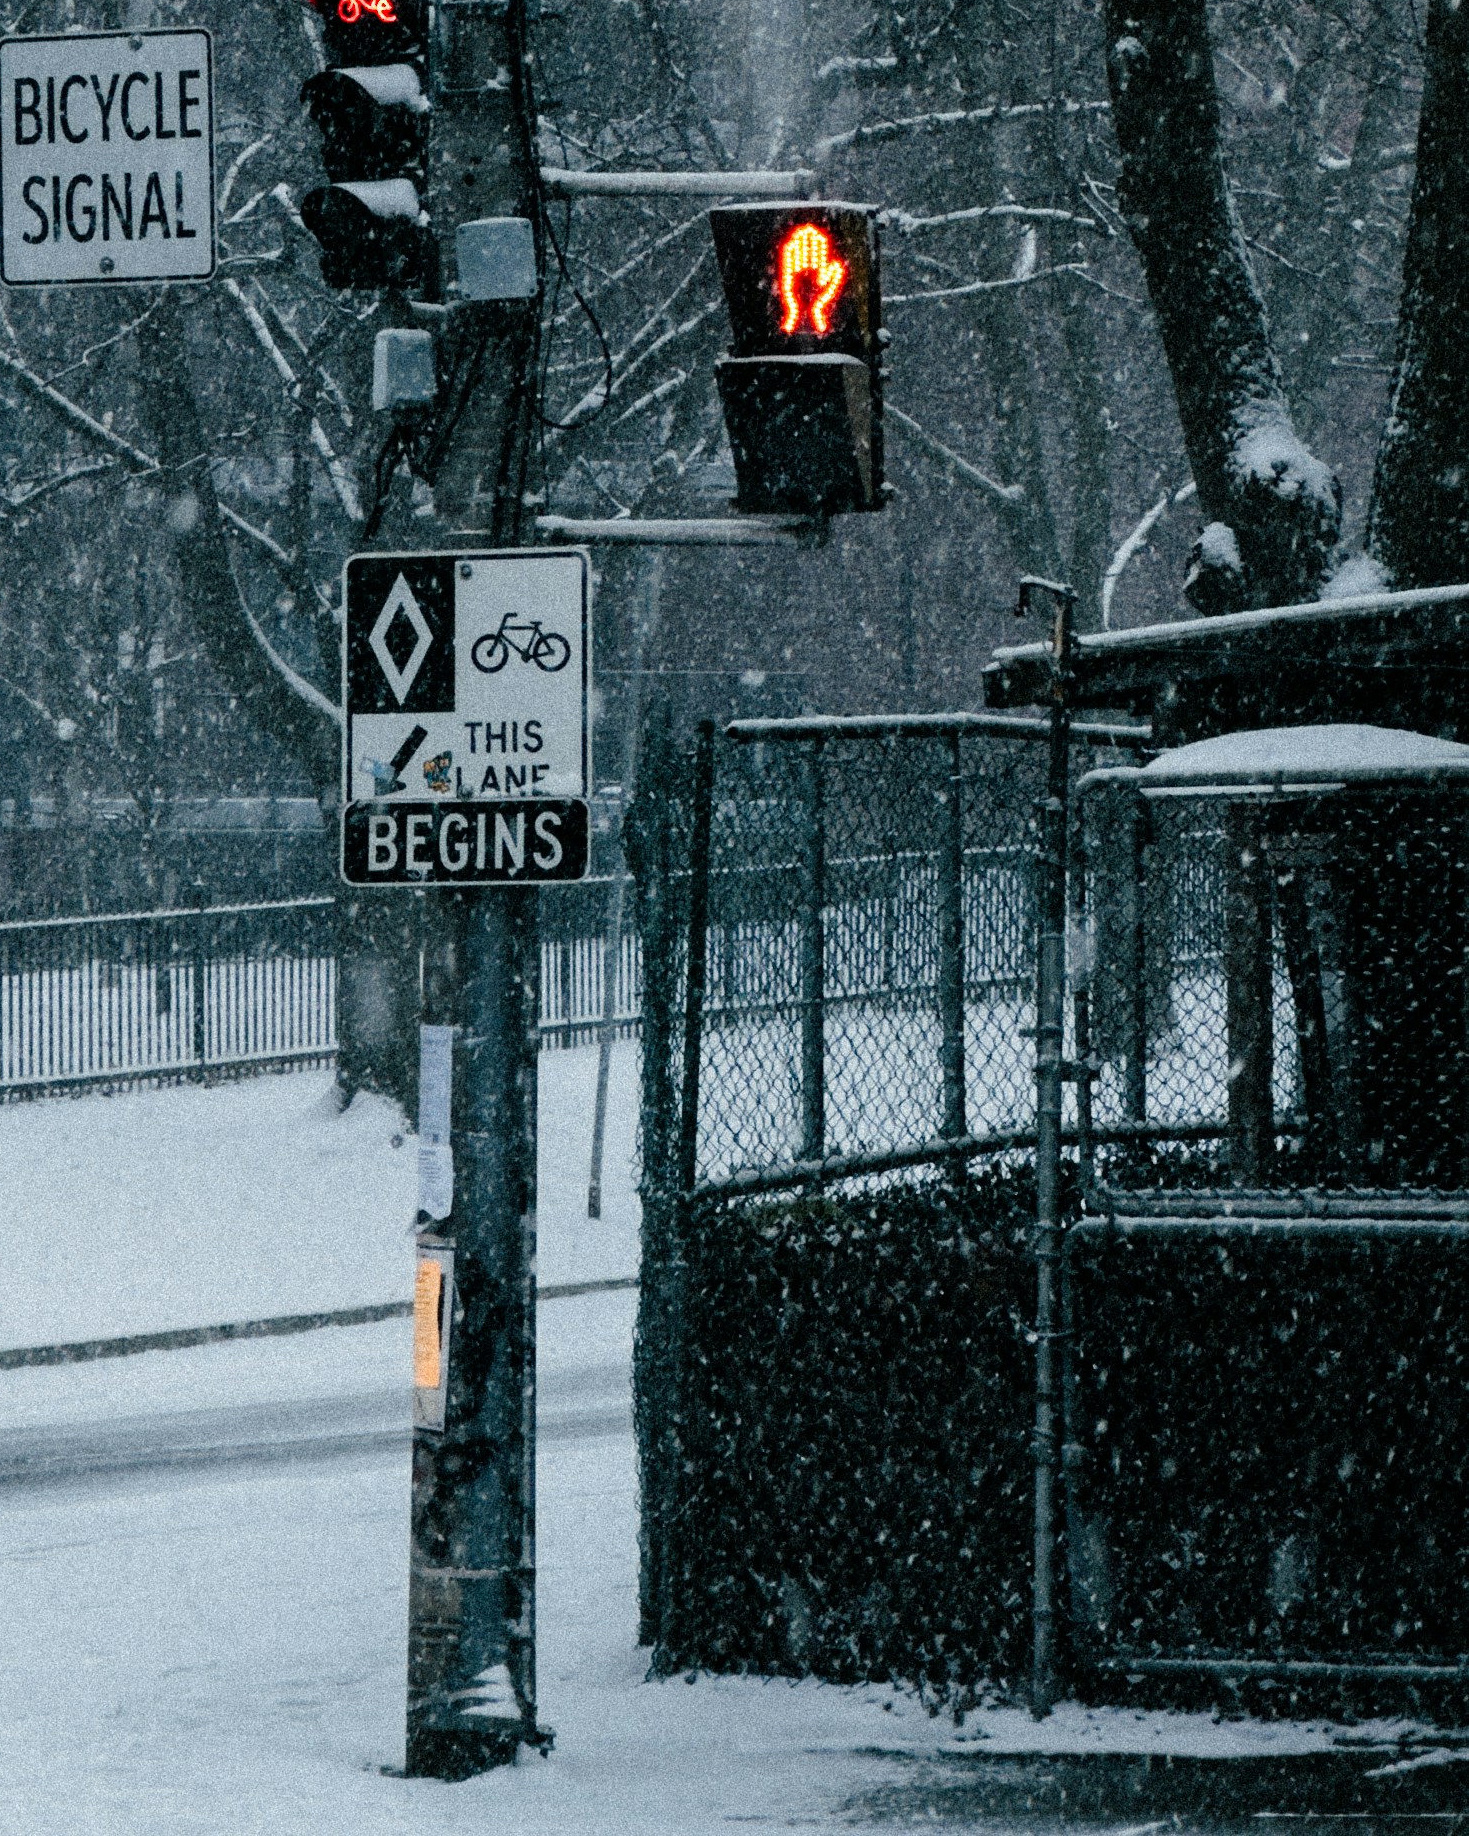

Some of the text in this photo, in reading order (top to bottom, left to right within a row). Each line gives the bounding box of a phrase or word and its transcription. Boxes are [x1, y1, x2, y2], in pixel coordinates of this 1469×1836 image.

[14, 69, 202, 145] BICYCLE
[22, 171, 196, 245] SIGNAL
[464, 720, 543, 753] THIS
[368, 811, 563, 871] BEGINS
